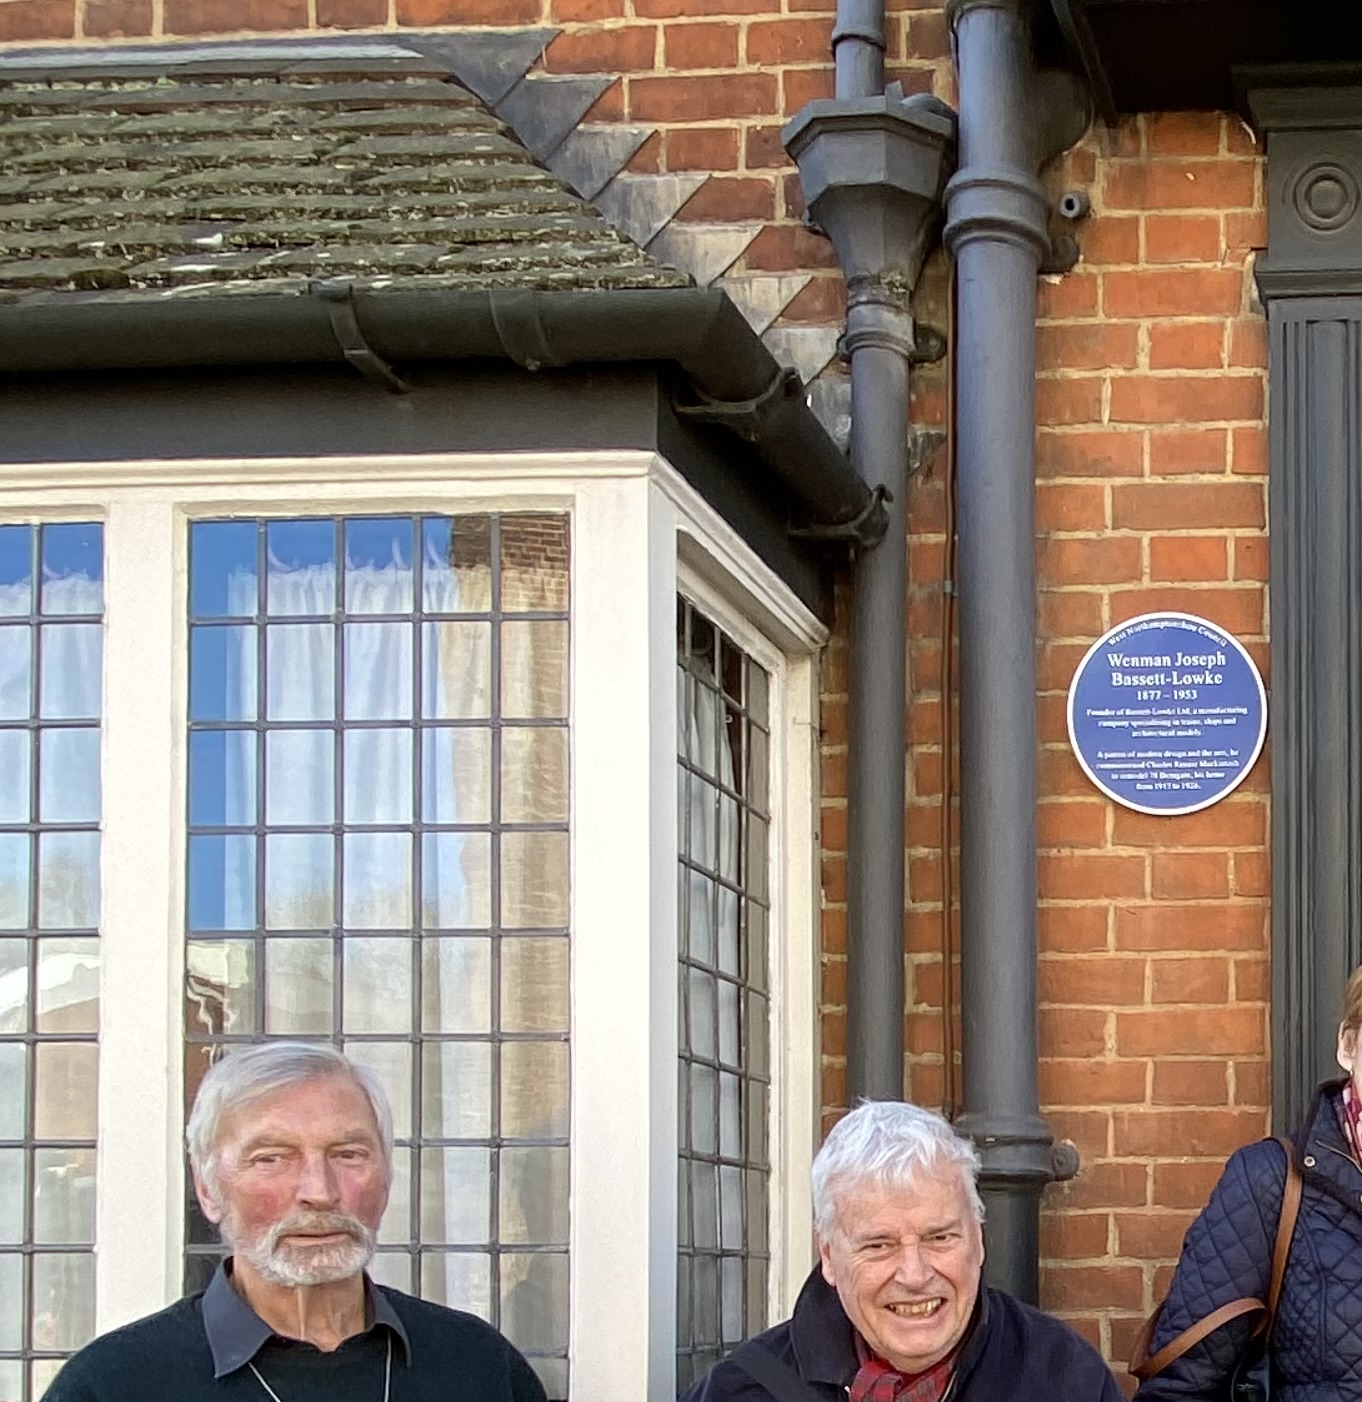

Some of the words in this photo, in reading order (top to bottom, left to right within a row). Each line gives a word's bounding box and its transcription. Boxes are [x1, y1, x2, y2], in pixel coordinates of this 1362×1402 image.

[1107, 653, 1171, 667] Wenman
[1174, 651, 1227, 669] Joseph
[1111, 670, 1223, 686] Bassett-Lowke
[1137, 690, 1161, 700] 1877
[1173, 689, 1198, 700] 1953
